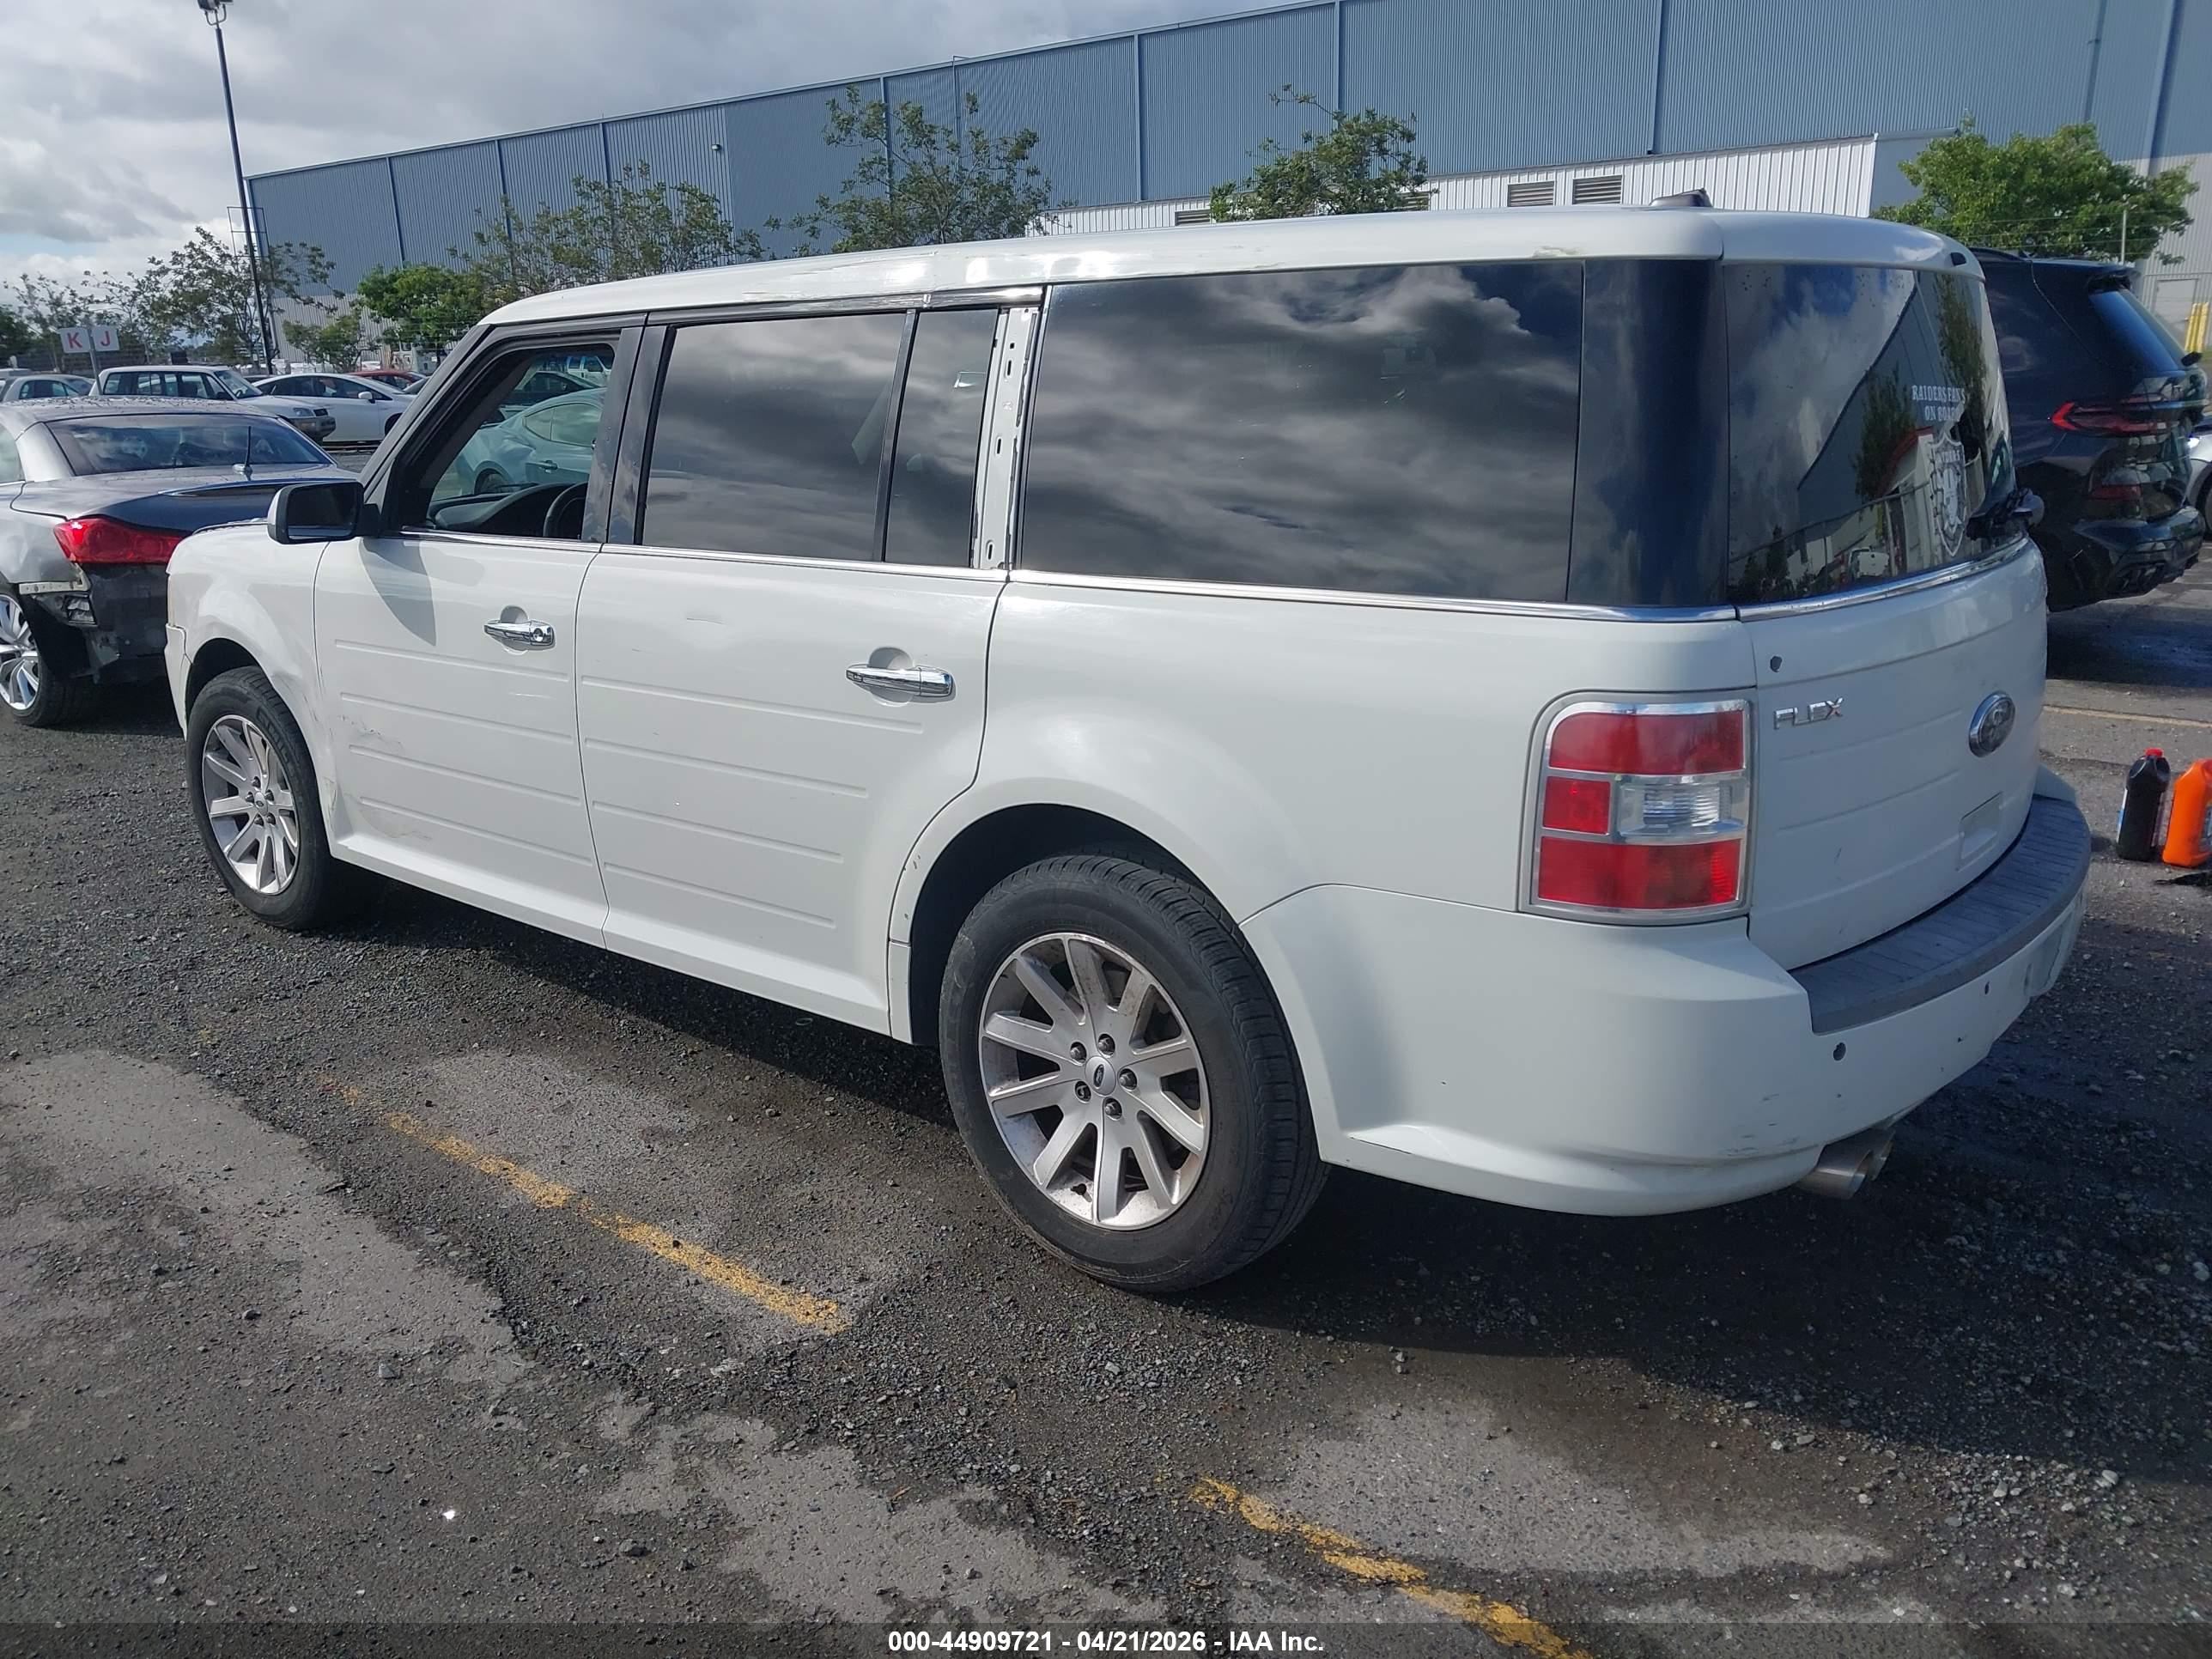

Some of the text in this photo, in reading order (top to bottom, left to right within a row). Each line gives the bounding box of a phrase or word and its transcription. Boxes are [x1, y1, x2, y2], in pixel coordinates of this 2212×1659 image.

[66, 331, 83, 349] K
[100, 331, 111, 347] J
[1911, 385, 1947, 403] RAIDERS
[1924, 406, 1962, 422] ON BOAR
[1772, 697, 1844, 730] FLEX
